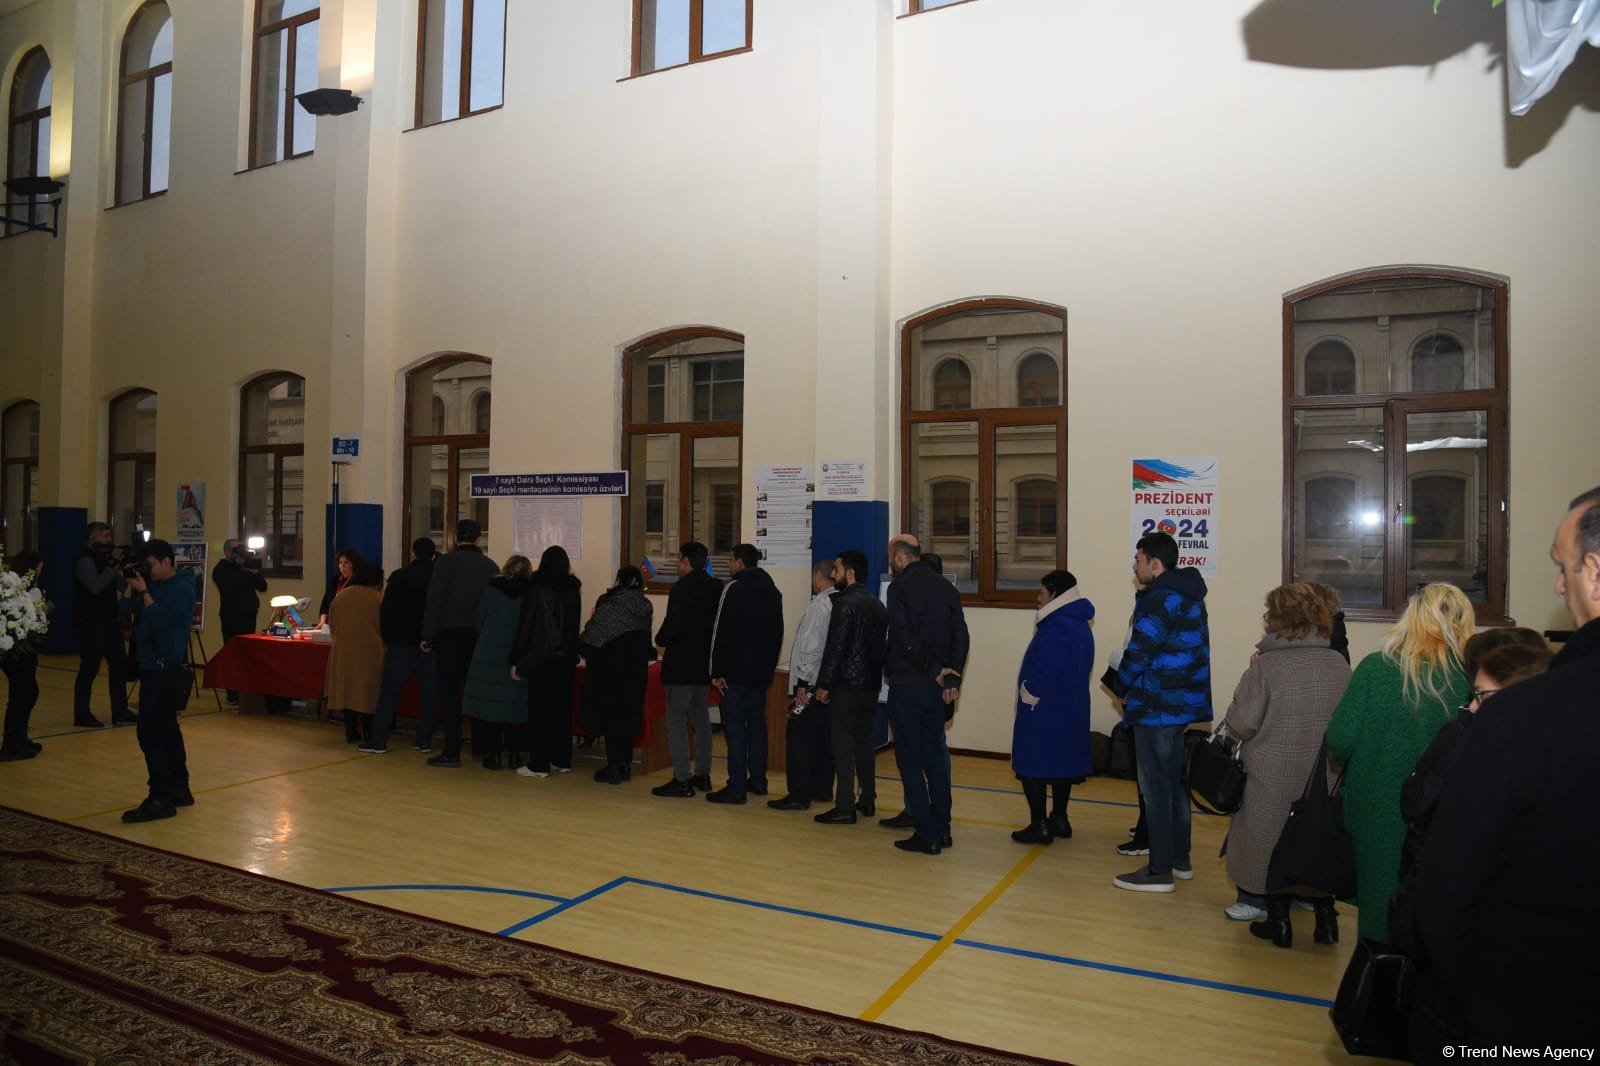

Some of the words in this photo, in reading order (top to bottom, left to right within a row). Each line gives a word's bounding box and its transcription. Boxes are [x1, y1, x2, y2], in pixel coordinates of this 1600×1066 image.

[535, 476, 554, 485] Seçki
[557, 475, 599, 484] Komissiyası
[498, 486, 517, 495] Seçki
[517, 486, 562, 495] məntəqəsinin
[563, 485, 598, 494] komissiya
[599, 484, 623, 493] üzvləri
[1135, 490, 1213, 504] PREZİDENT
[1165, 507, 1211, 517] SEÇKİLƏRİ
[1178, 540, 1209, 549] FEVRAL
[1179, 556, 1206, 566] RƏK!
